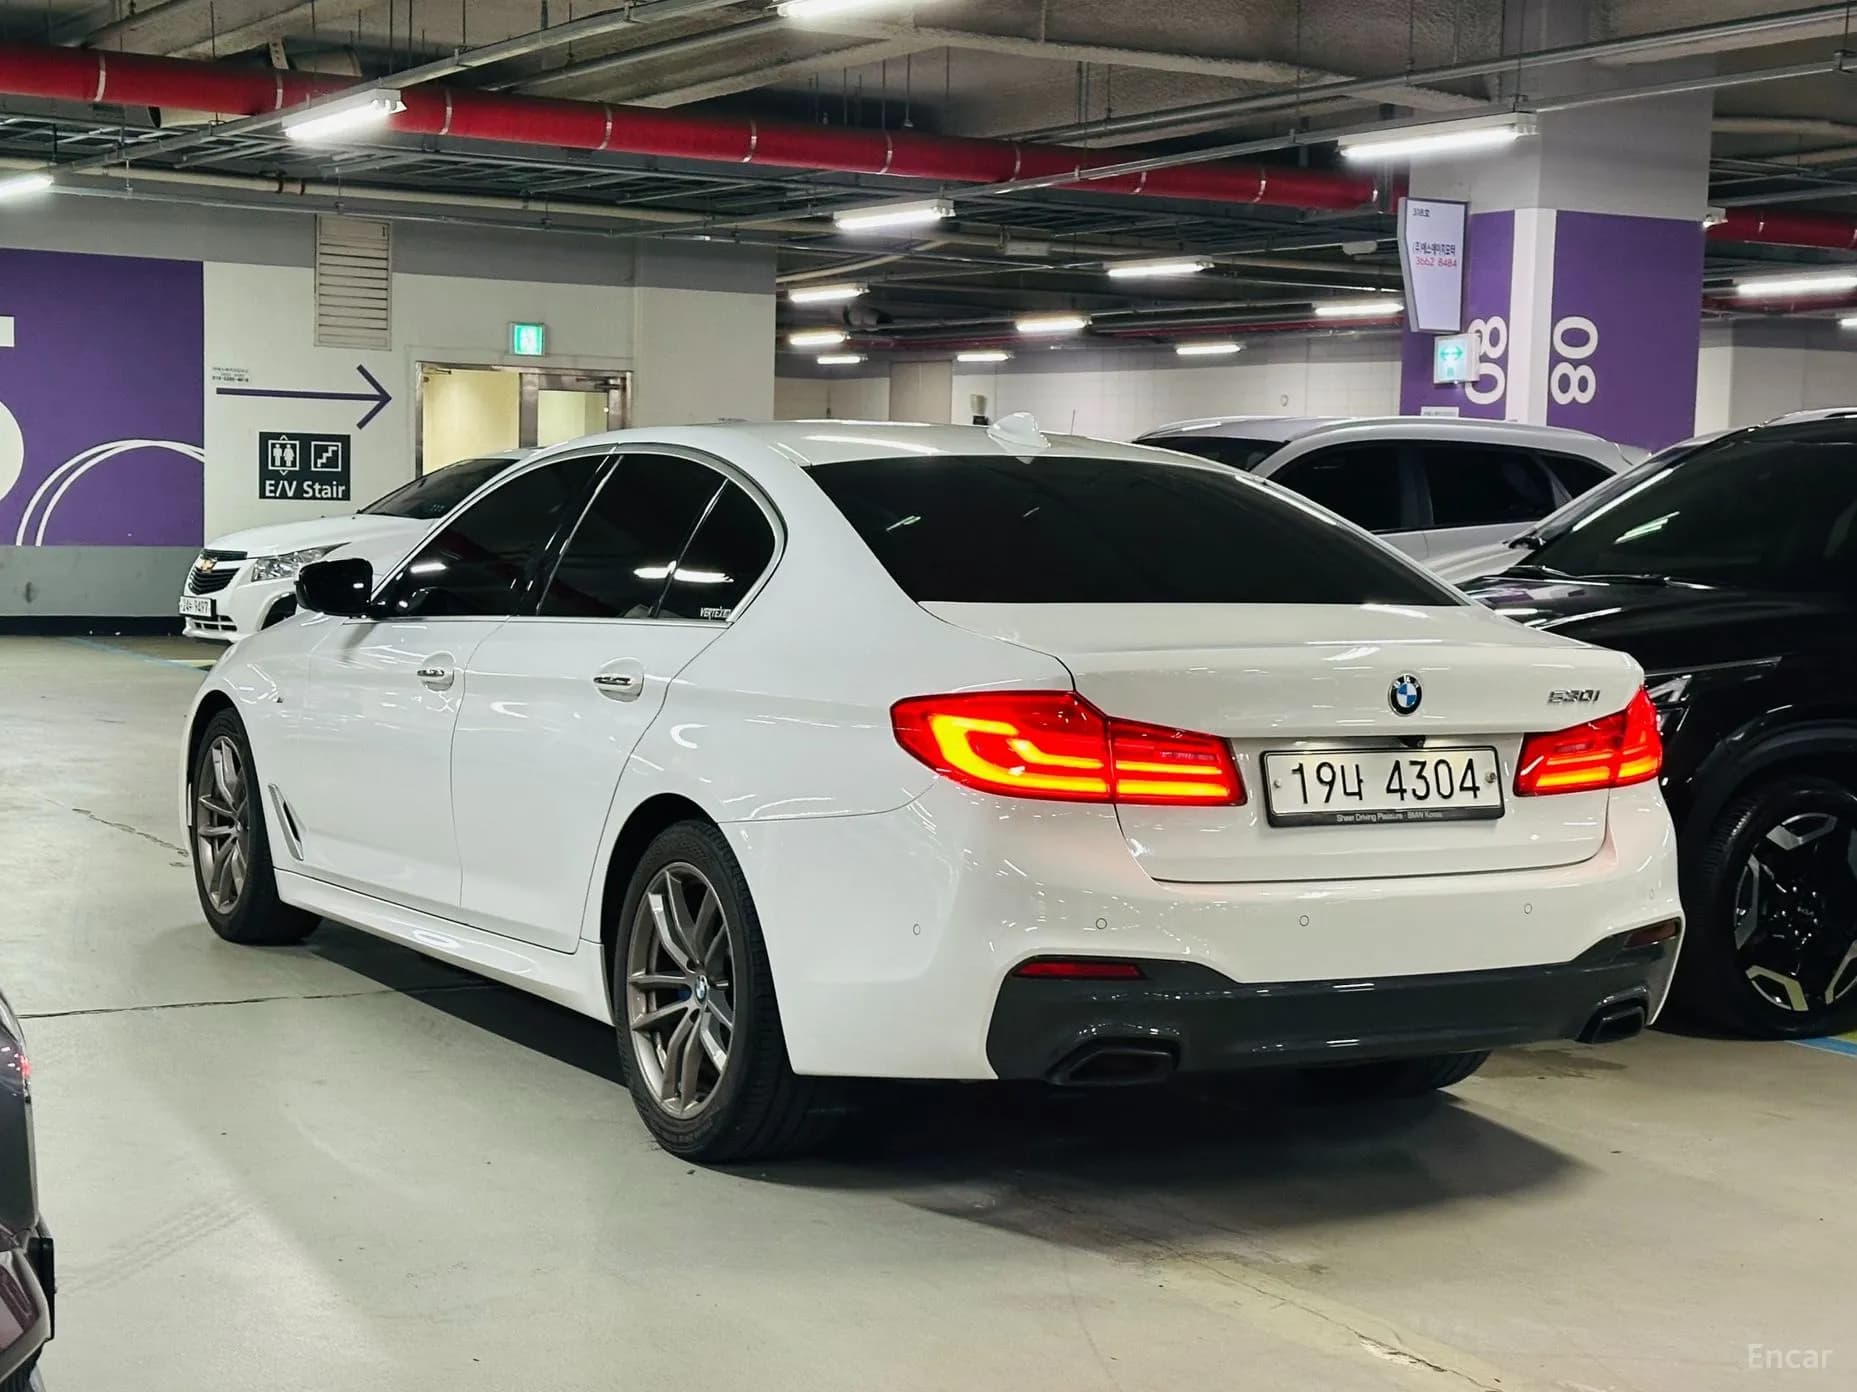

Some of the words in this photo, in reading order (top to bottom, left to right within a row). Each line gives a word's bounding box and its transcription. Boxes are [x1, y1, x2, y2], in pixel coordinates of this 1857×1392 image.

[265, 480, 297, 497] E/V
[303, 481, 346, 498] Stair
[1292, 762, 1363, 804] 19나
[1385, 758, 1480, 801] 4304
[1355, 813, 1377, 822] Driving
[1407, 811, 1423, 819] BMW
